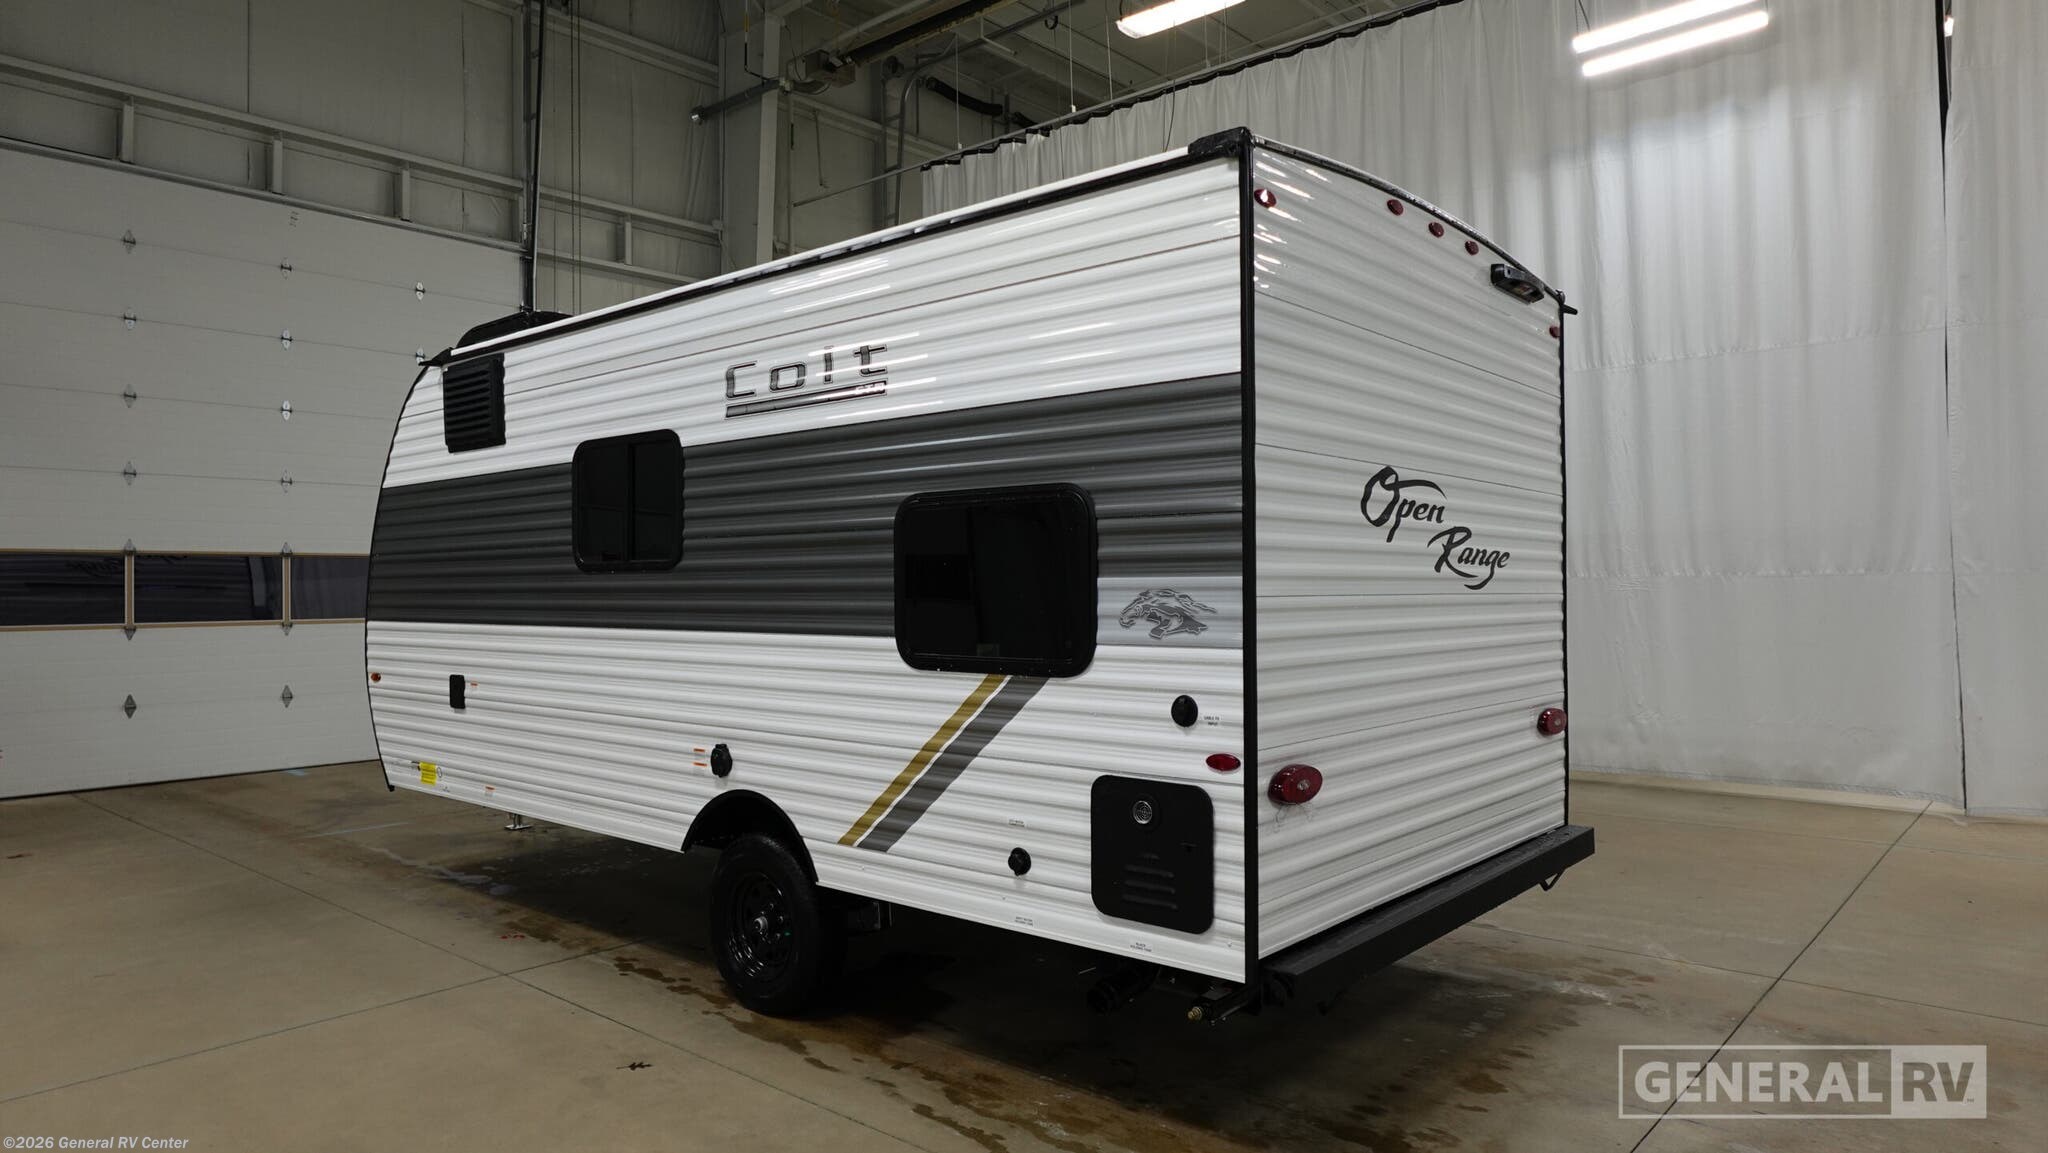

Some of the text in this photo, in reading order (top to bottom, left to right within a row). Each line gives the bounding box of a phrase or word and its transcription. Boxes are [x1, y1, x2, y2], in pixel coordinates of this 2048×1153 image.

[726, 344, 888, 398] Colt
[1360, 465, 1448, 543] Open
[1427, 526, 1511, 590] Range
